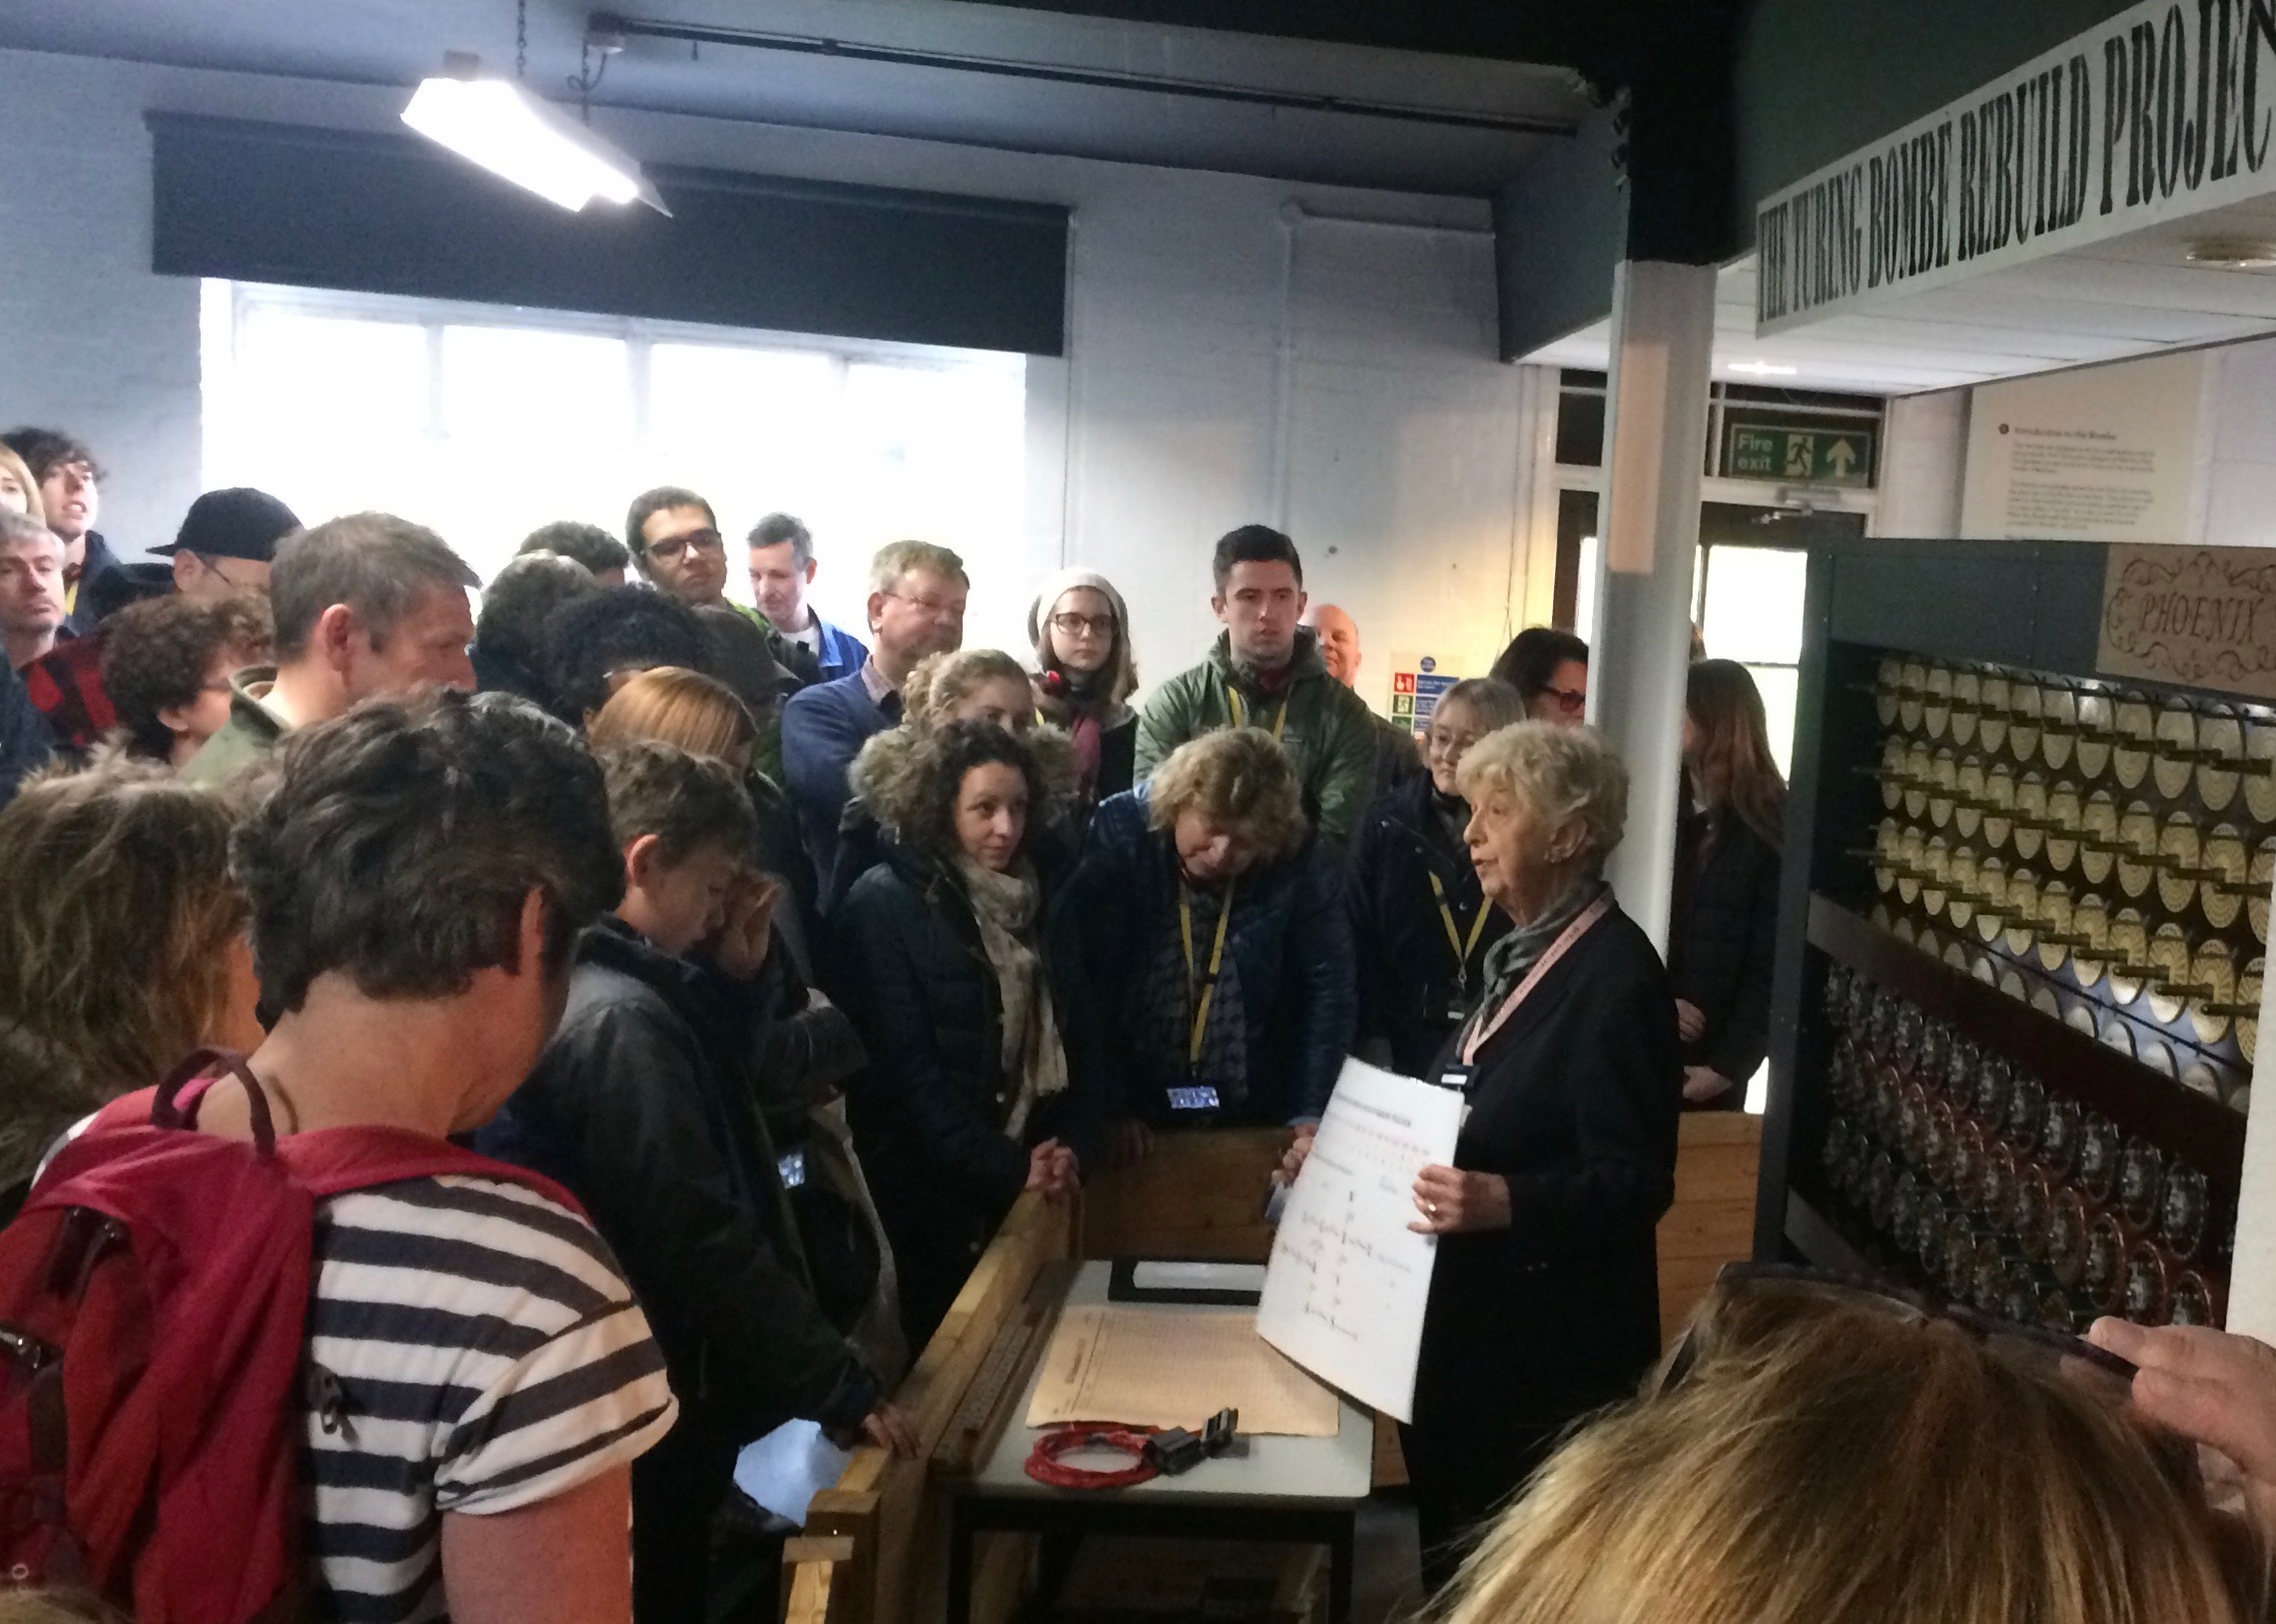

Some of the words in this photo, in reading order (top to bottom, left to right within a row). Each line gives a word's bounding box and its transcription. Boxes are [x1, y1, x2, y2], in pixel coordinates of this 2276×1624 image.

[1759, 202, 1789, 323] THE
[1793, 160, 1863, 313] TURING
[1868, 120, 1952, 290] BOMBE
[1957, 54, 2091, 262] REBUILD
[1738, 433, 1774, 451] Fire
[1738, 453, 1772, 471] exit
[2139, 590, 2265, 646] PHOENIX
